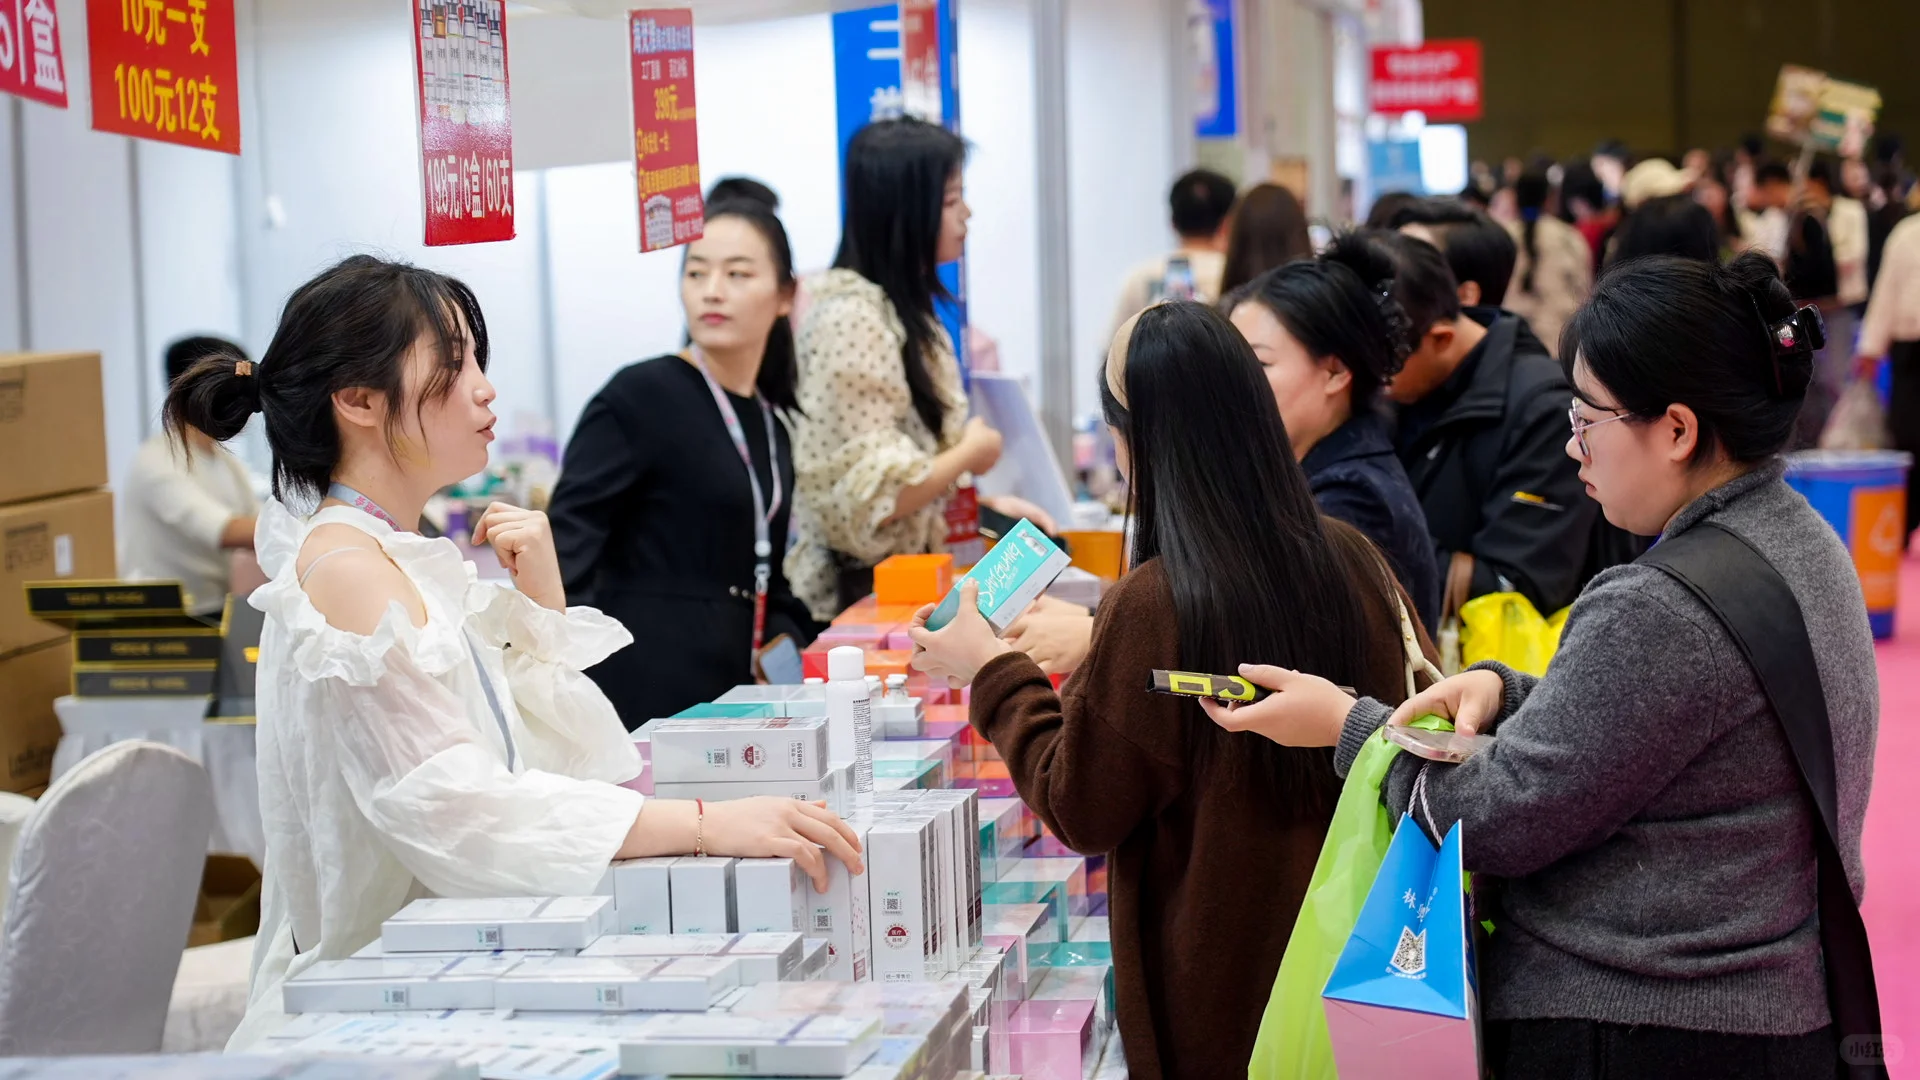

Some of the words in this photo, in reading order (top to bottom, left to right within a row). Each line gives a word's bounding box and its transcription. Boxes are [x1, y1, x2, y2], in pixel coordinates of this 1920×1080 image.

[121, 0, 210, 56] 10元一支
[114, 63, 221, 141] 100元12支
